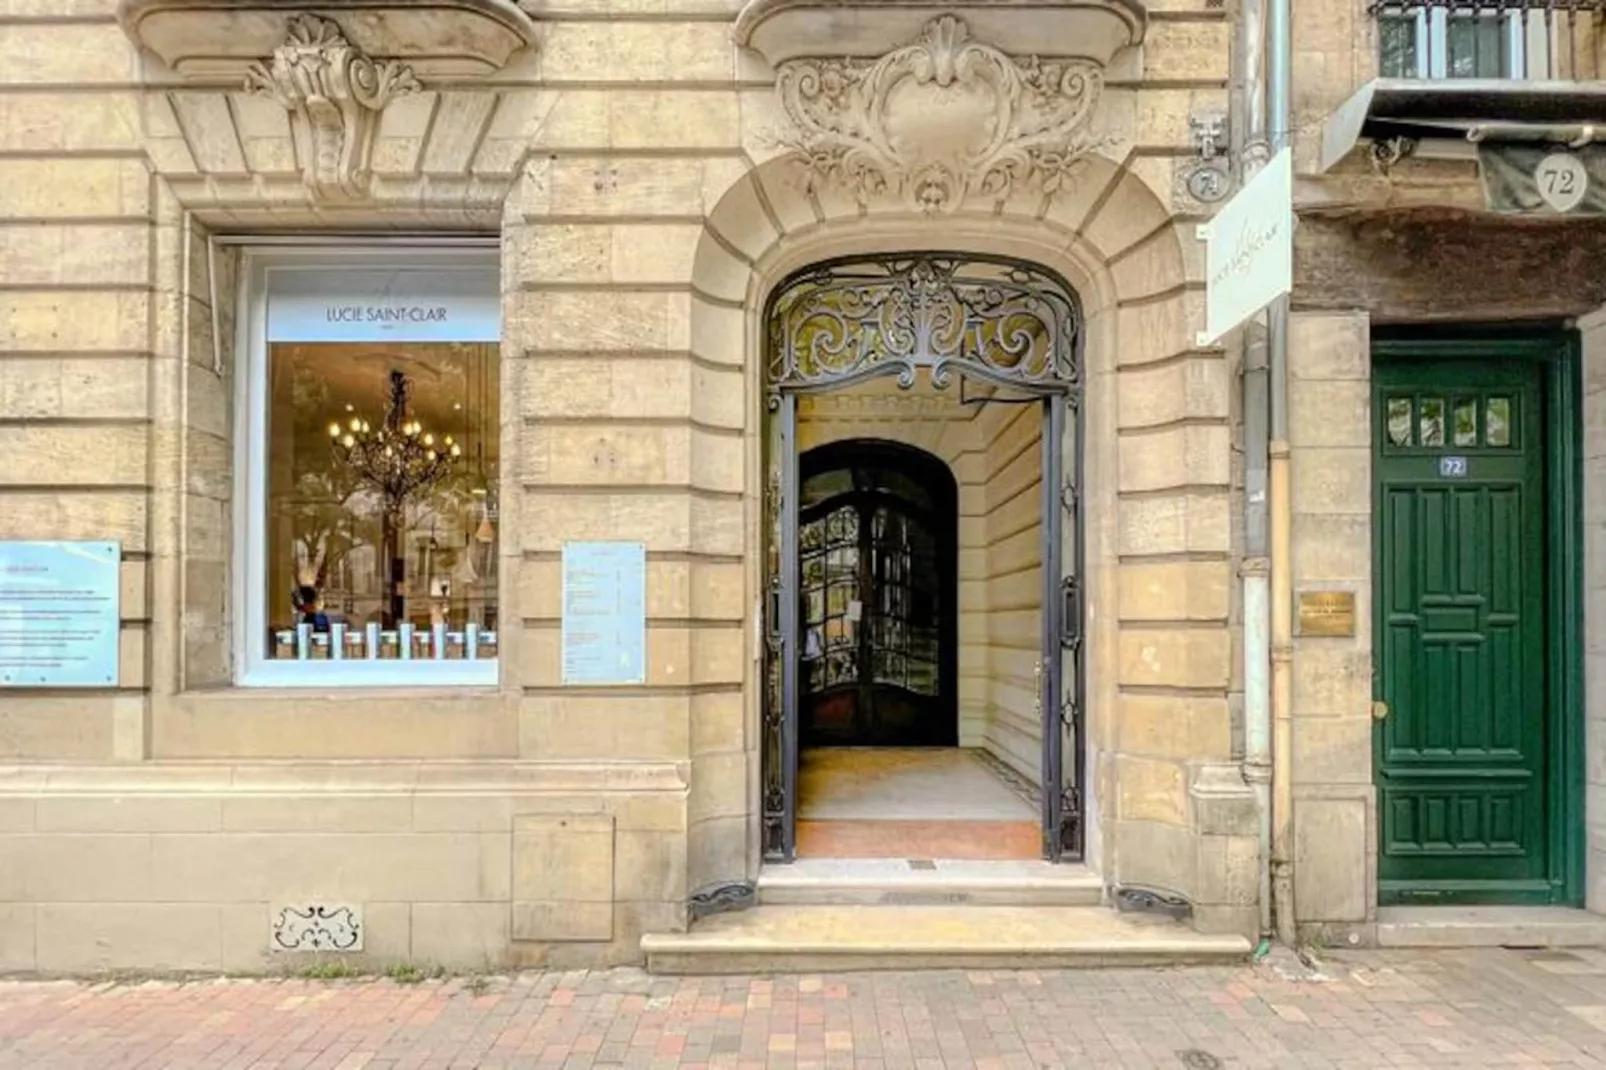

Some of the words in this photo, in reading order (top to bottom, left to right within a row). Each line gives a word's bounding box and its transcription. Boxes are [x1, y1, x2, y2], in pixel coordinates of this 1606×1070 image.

[1544, 168, 1575, 195] 72
[326, 307, 364, 322] LUCIE
[1444, 459, 1462, 475] 72
